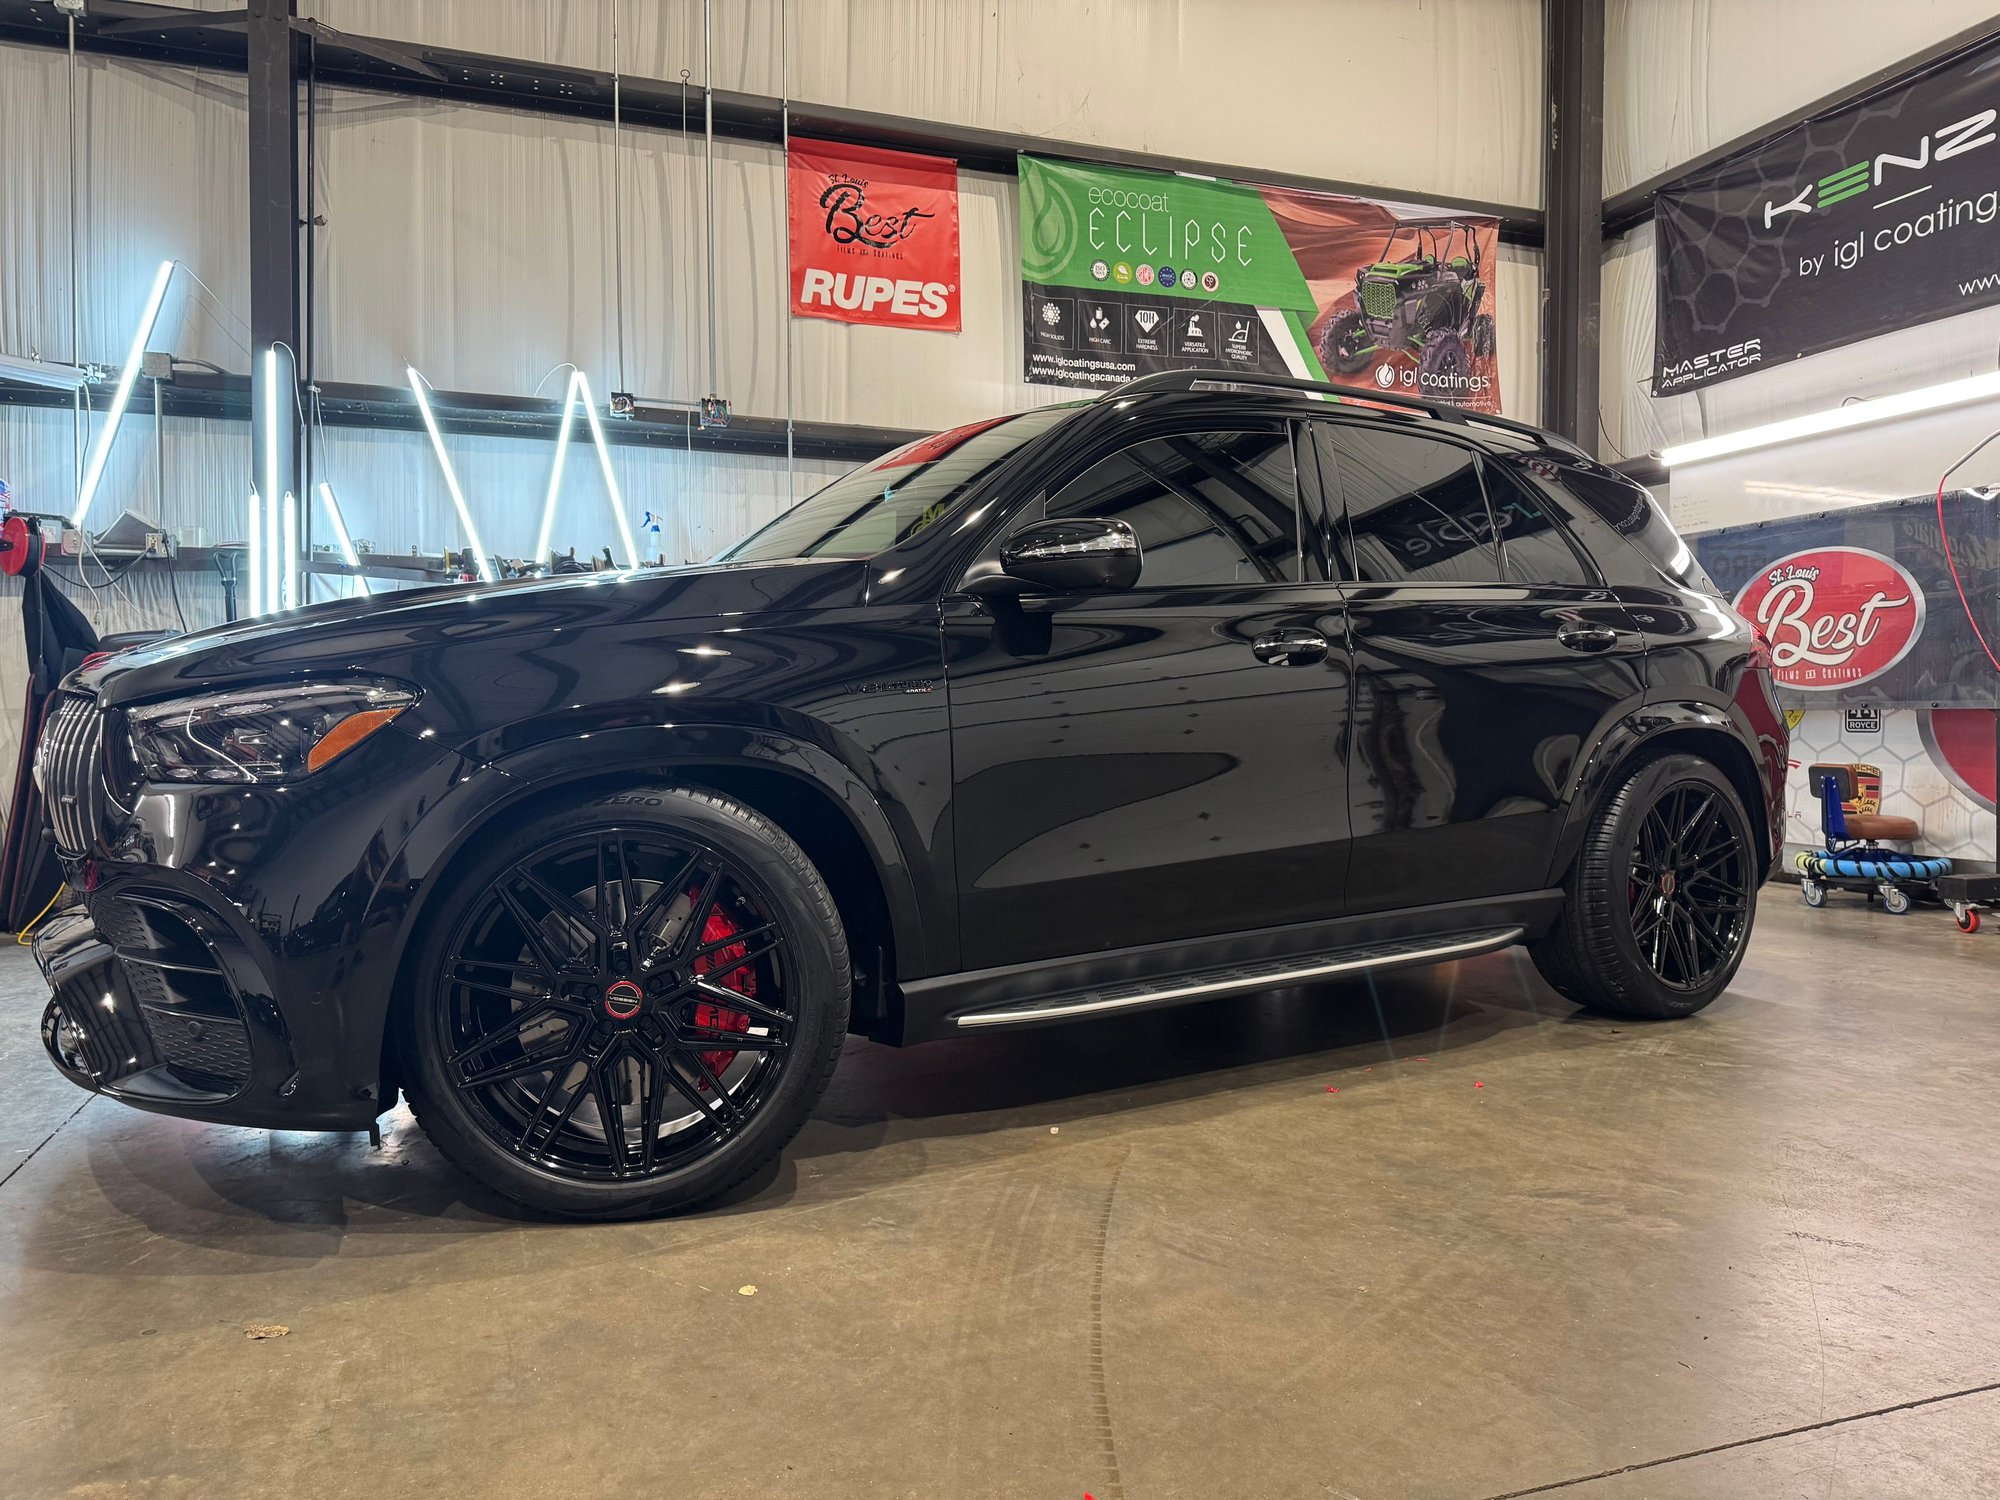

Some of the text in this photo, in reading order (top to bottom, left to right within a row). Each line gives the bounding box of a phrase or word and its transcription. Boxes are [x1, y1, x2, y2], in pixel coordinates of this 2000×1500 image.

[842, 173, 869, 188] Louis
[1764, 108, 1997, 229] KENZ
[1088, 186, 1169, 212] ecocoat
[819, 183, 936, 249] Best
[1089, 207, 1252, 266] ECLIPSE
[1799, 191, 2000, 277] by igl coating
[1139, 311, 1155, 324] 10H
[1032, 353, 1136, 372] www.iglcoatingsusa.com
[1661, 353, 1762, 389] APPLICATOR
[1663, 338, 1761, 378] MASTER
[1399, 365, 1490, 392] igl coatings
[1768, 570, 1785, 587] St.
[1785, 564, 1820, 582] Louis
[1757, 579, 1910, 667] Best
[1776, 669, 1800, 680] FILMS
[1822, 666, 1862, 679] COATINGS
[1850, 721, 1876, 729] ROYCE
